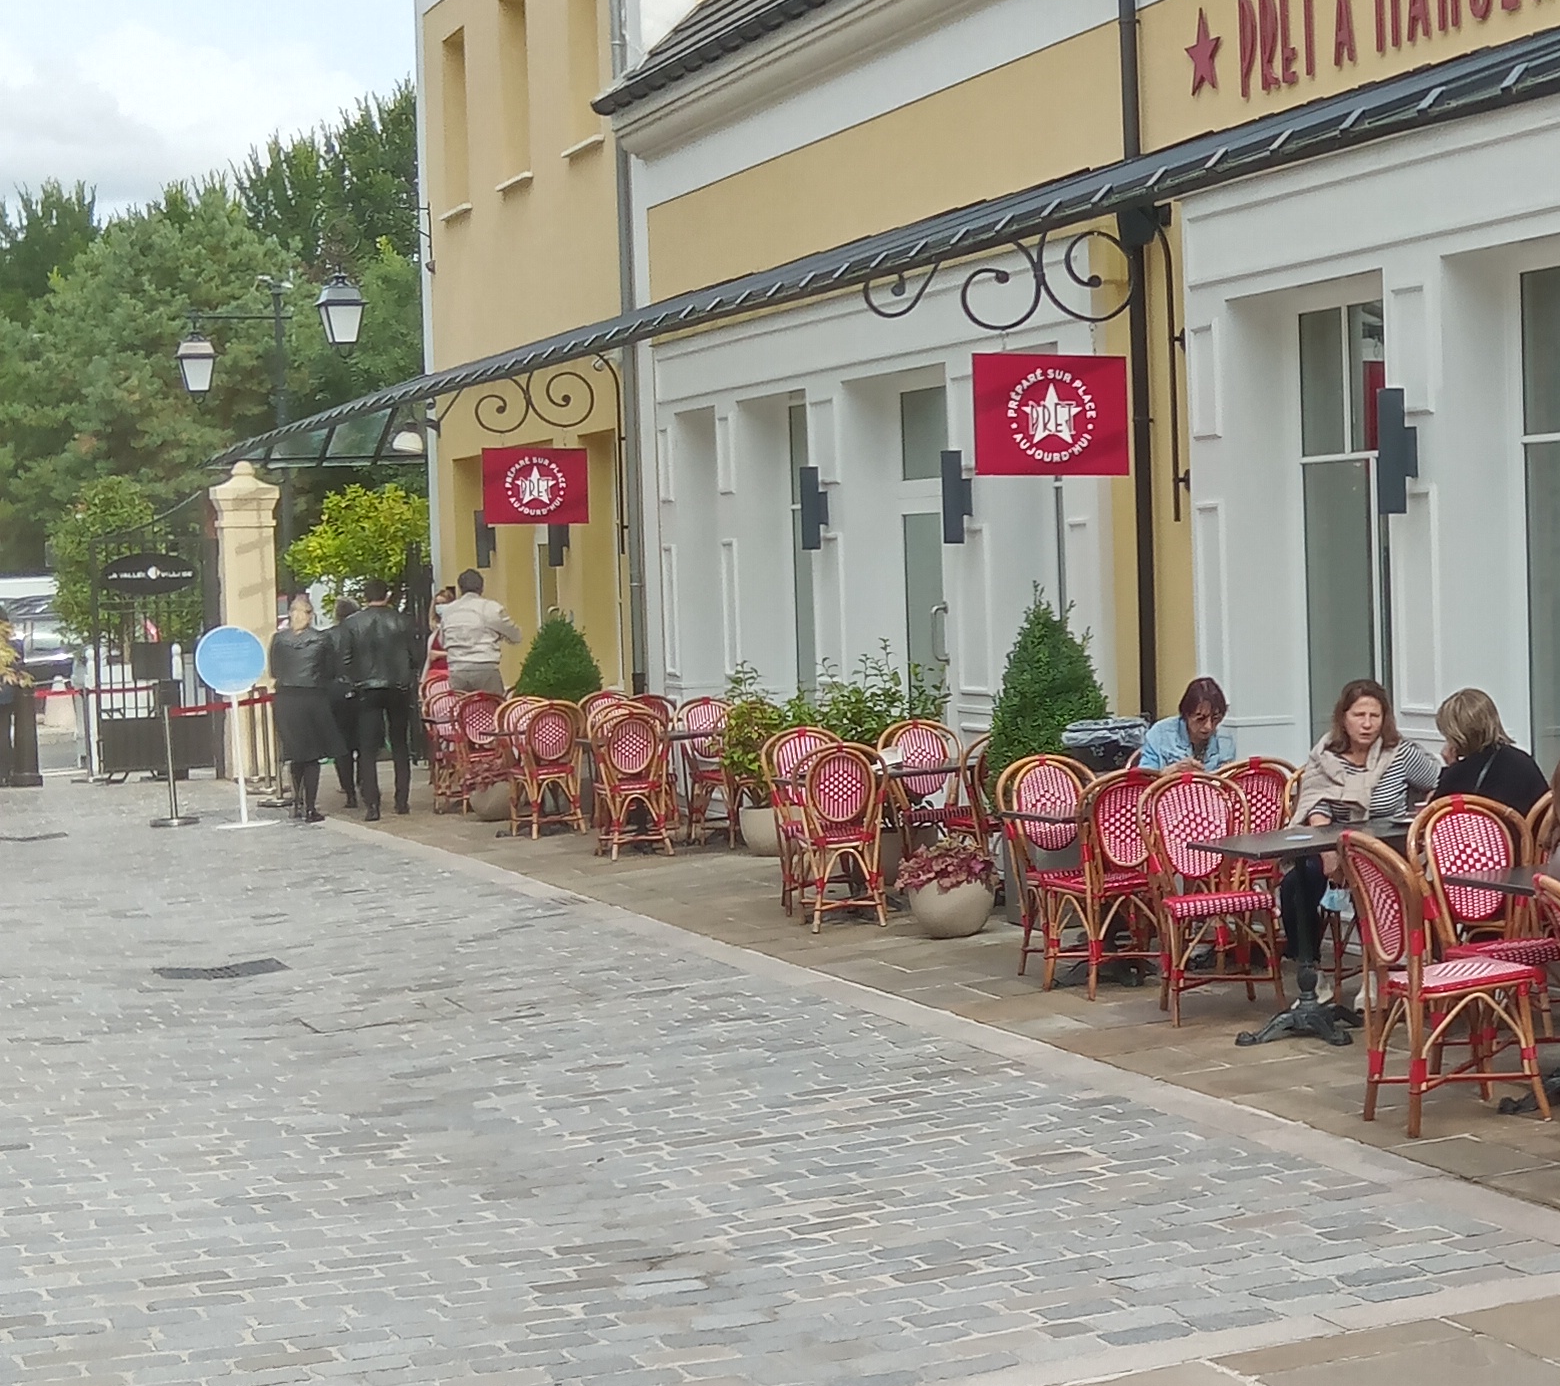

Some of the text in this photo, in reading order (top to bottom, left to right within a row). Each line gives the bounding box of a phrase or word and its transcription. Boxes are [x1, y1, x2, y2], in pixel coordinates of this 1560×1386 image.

[1007, 368, 1096, 419] PRÉPARÉ SUR PLACE
[1029, 400, 1076, 435] PRET
[1013, 433, 1092, 462] AUJOURD'HUI
[520, 477, 552, 498] PRET
[550, 463, 566, 488] PLACE
